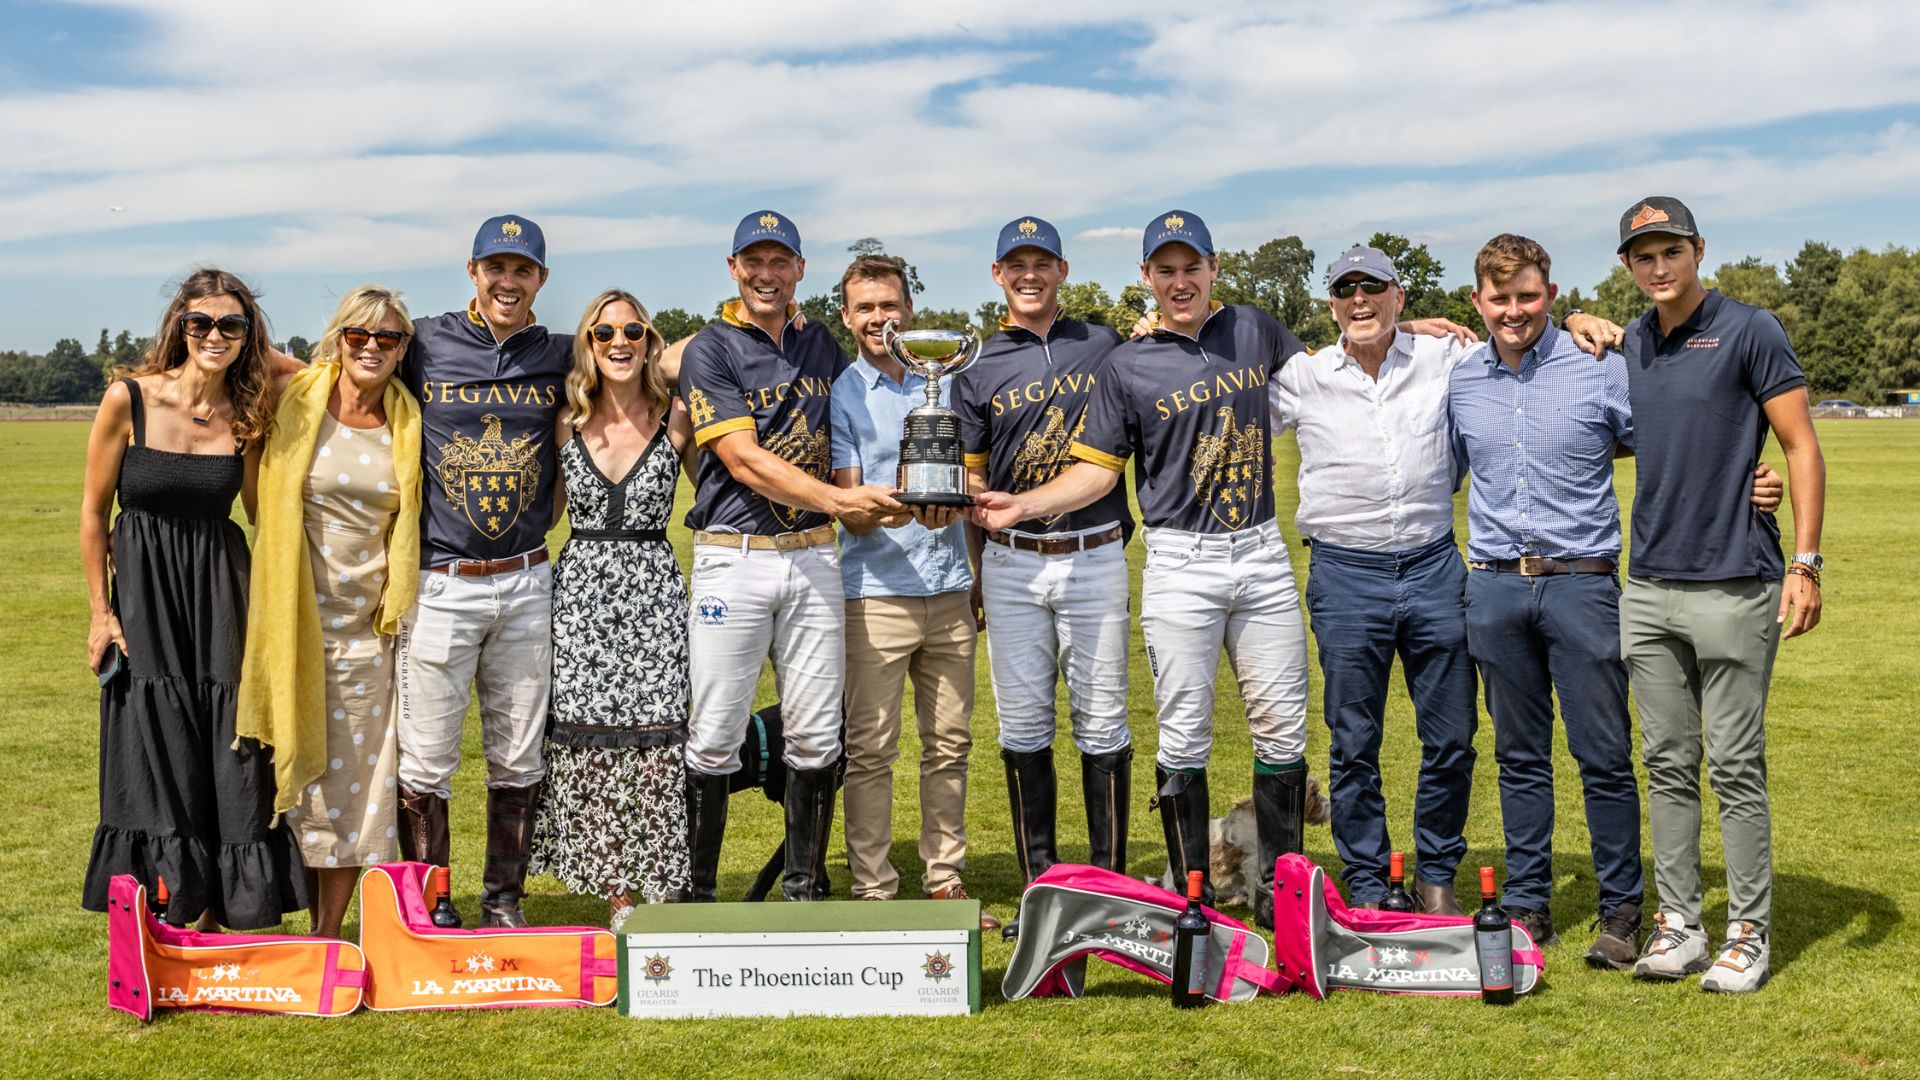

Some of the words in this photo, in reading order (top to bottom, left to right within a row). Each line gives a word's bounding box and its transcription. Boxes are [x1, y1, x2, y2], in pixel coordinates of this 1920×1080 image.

[423, 381, 556, 407] SEGAVAS
[991, 373, 1097, 417] SEGAVA
[1155, 364, 1266, 421] SEGAVAS
[402, 694, 411, 719] POLO
[1100, 932, 1173, 969] MARTI
[450, 959, 464, 974] L
[500, 958, 519, 972] M
[1363, 967, 1478, 982] MARTINA
[449, 976, 564, 995] MARTINA
[692, 967, 733, 988] The
[739, 966, 854, 988] Phoenician
[860, 966, 904, 991] Cup
[192, 986, 303, 1002] MARTINA
[637, 989, 679, 998] GUARDS
[917, 987, 960, 996] GUARDS
